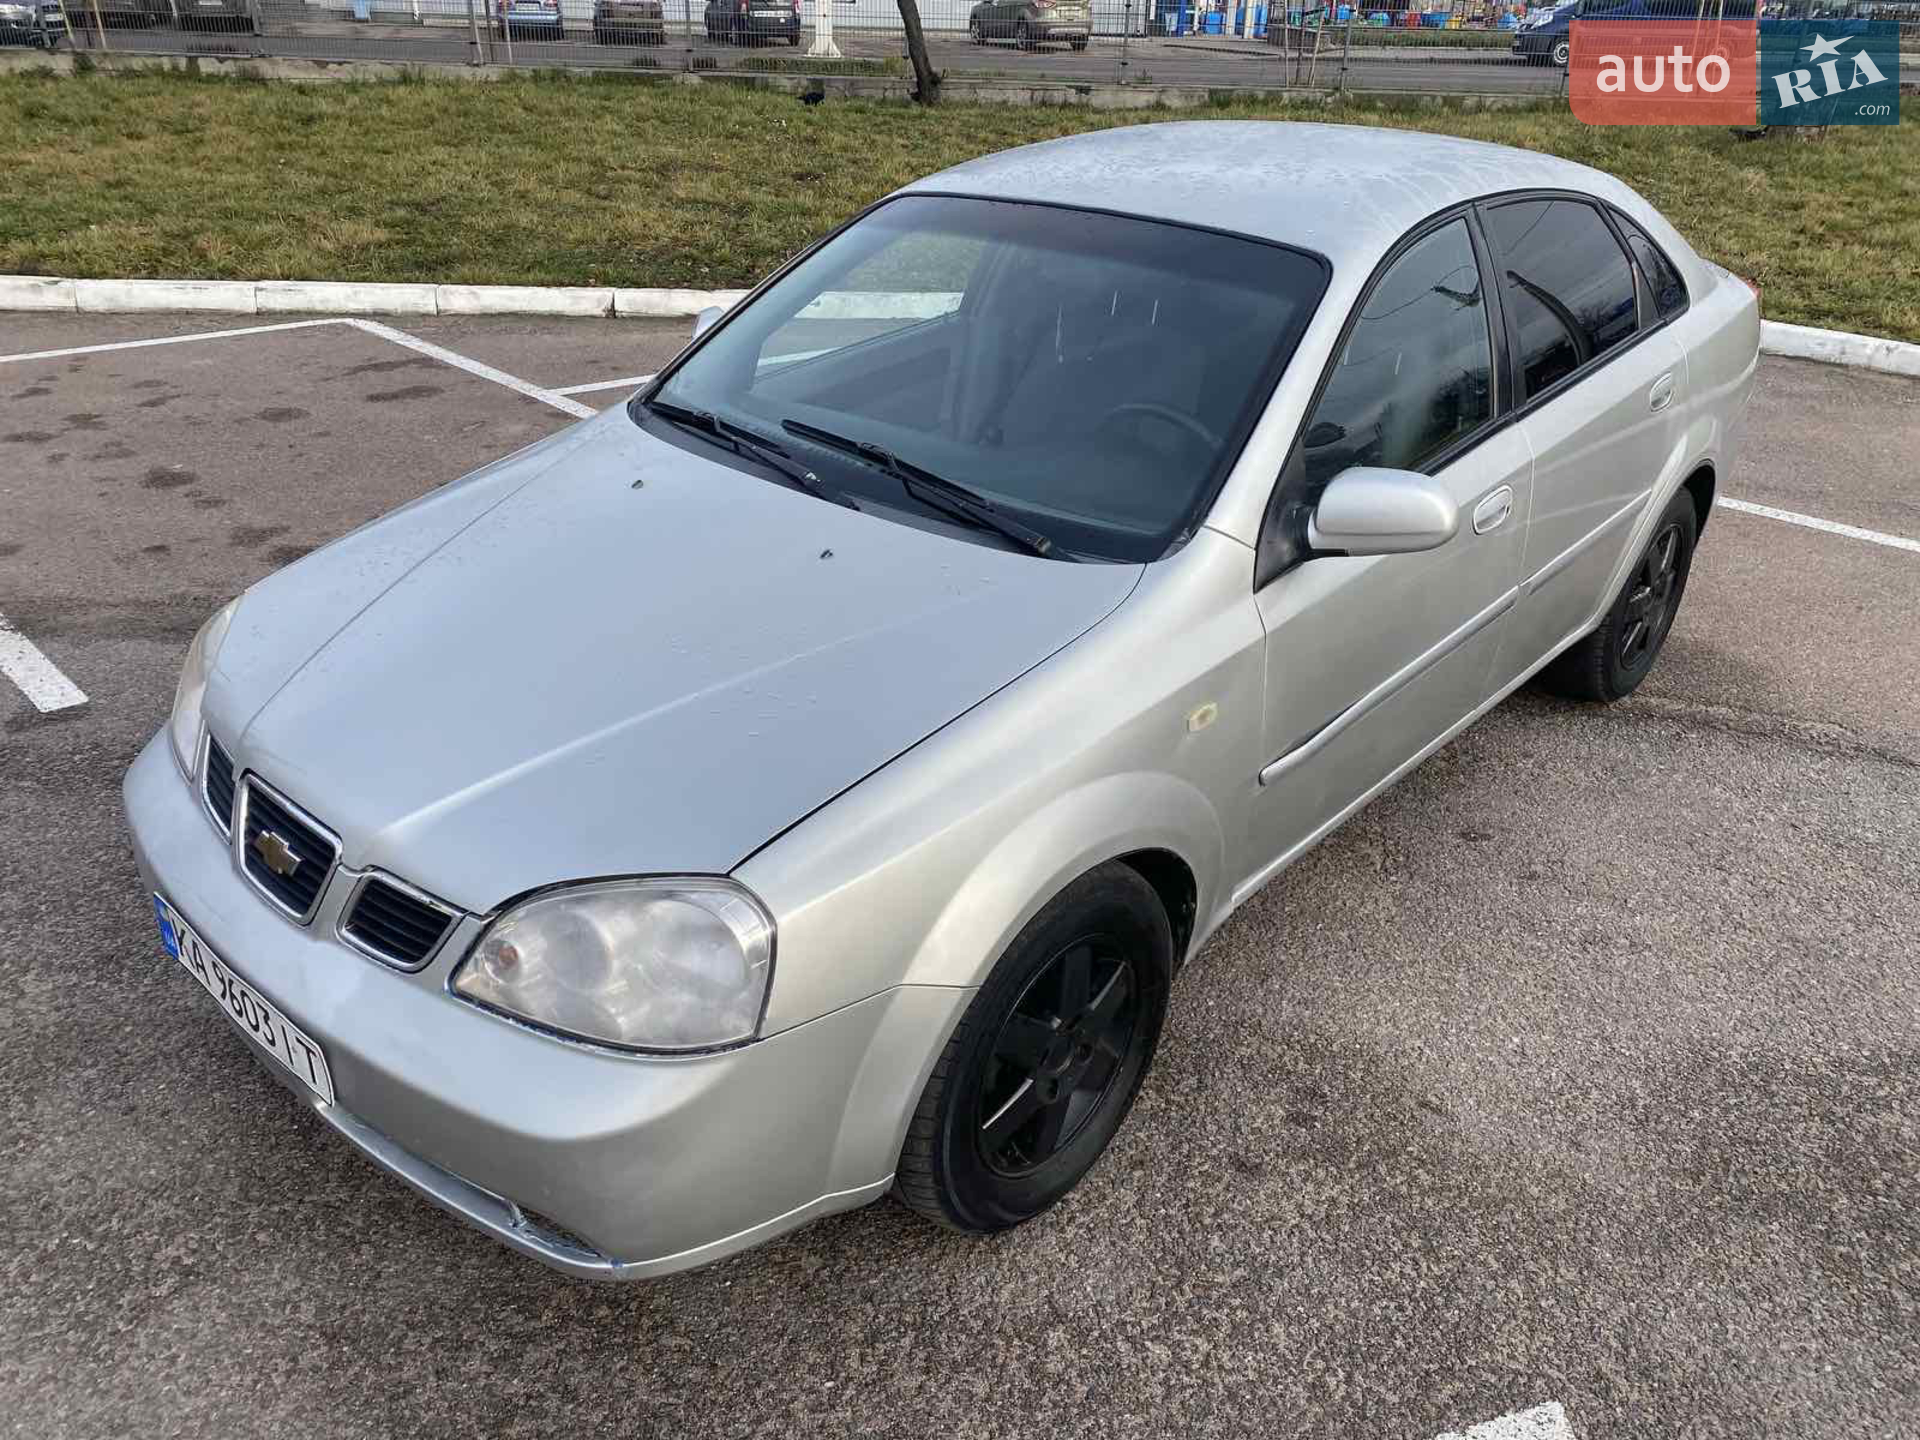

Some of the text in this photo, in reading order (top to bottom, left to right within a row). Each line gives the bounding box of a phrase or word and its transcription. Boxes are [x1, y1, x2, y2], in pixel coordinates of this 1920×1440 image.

[171, 919, 317, 1085] KA 9603 IT
